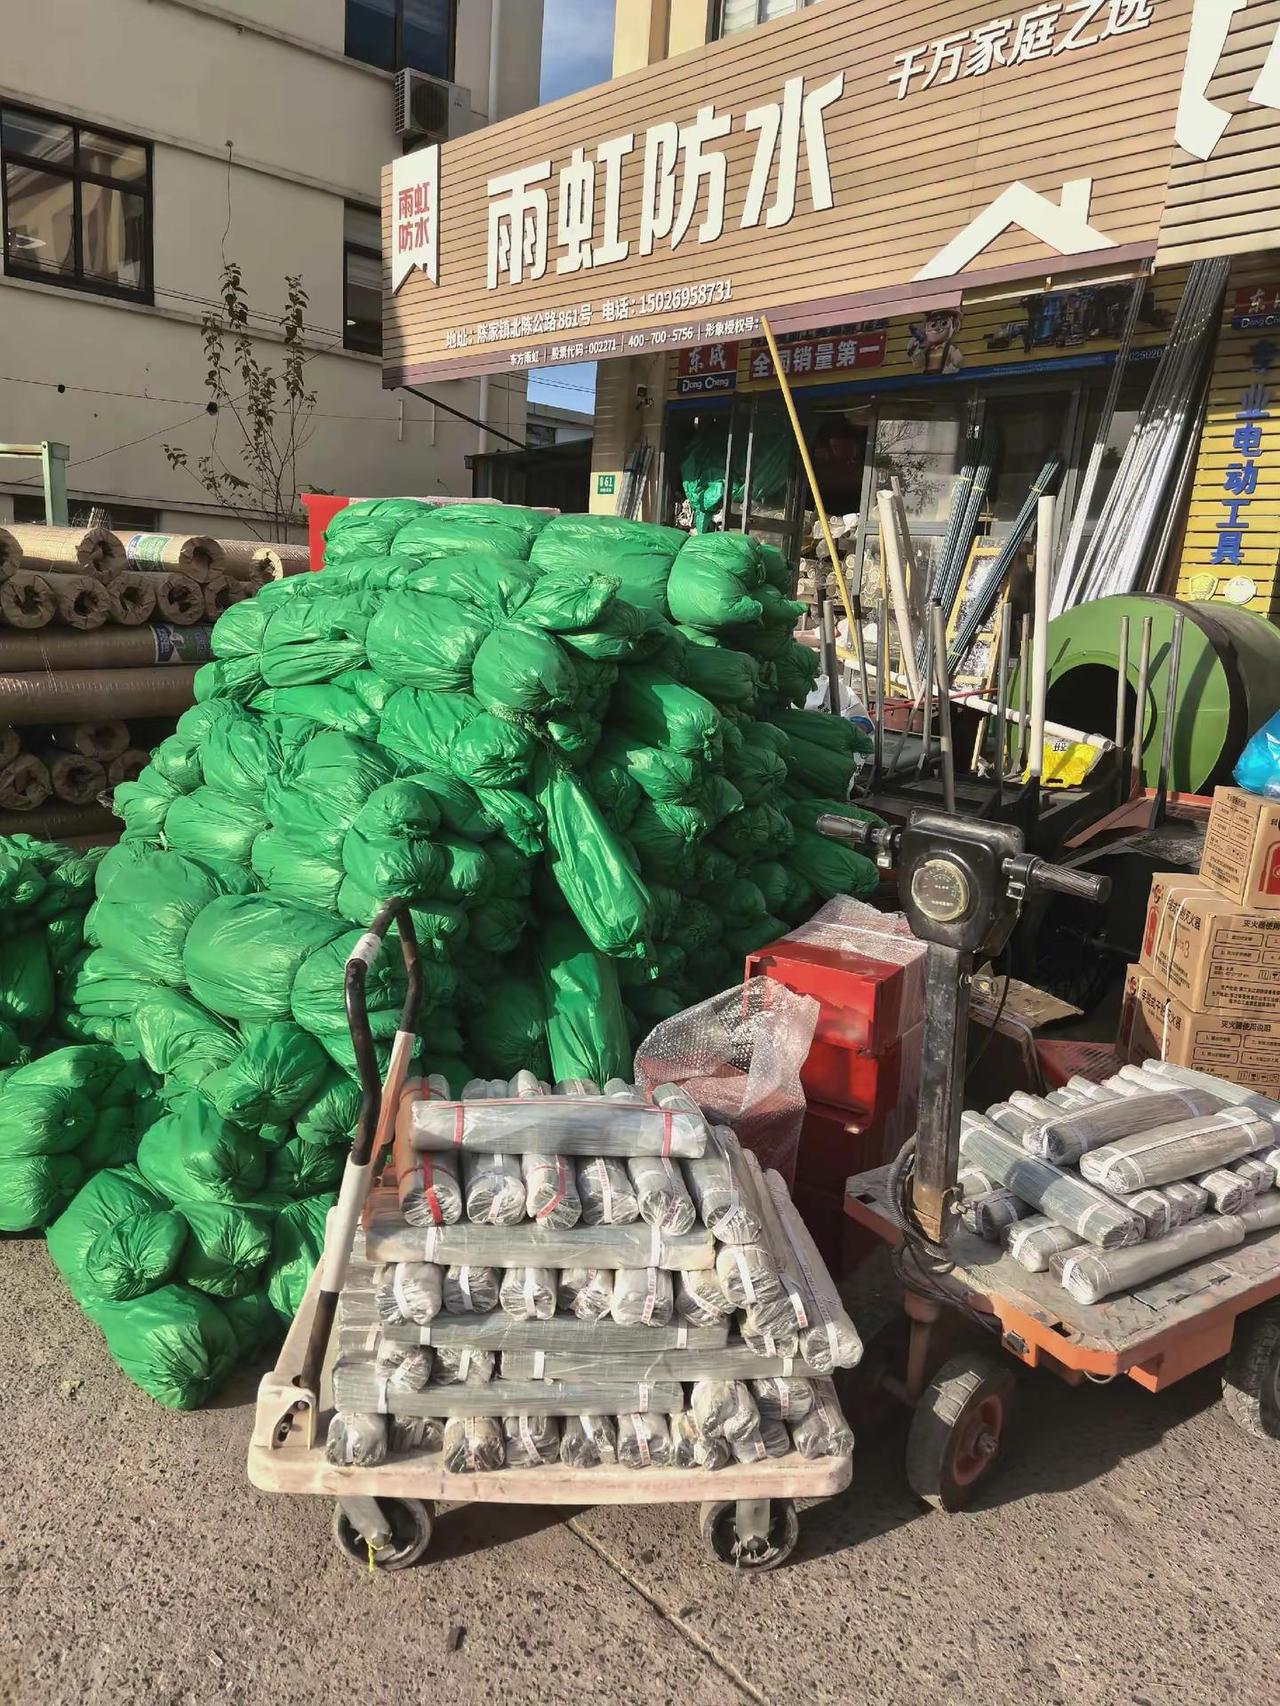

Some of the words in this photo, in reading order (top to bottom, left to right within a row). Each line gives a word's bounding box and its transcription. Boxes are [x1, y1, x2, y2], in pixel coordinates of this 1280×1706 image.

[888, 0, 1155, 99] 千万家庭之选
[487, 71, 844, 289] 雨虹防水
[398, 182, 430, 220] 雨虹
[398, 216, 430, 254] 防水
[602, 279, 733, 322] 电话：15026958731
[510, 350, 540, 366] 东方雨虹
[682, 379, 703, 392] Dong
[705, 376, 729, 389] Cheng
[599, 476, 613, 487] 861
